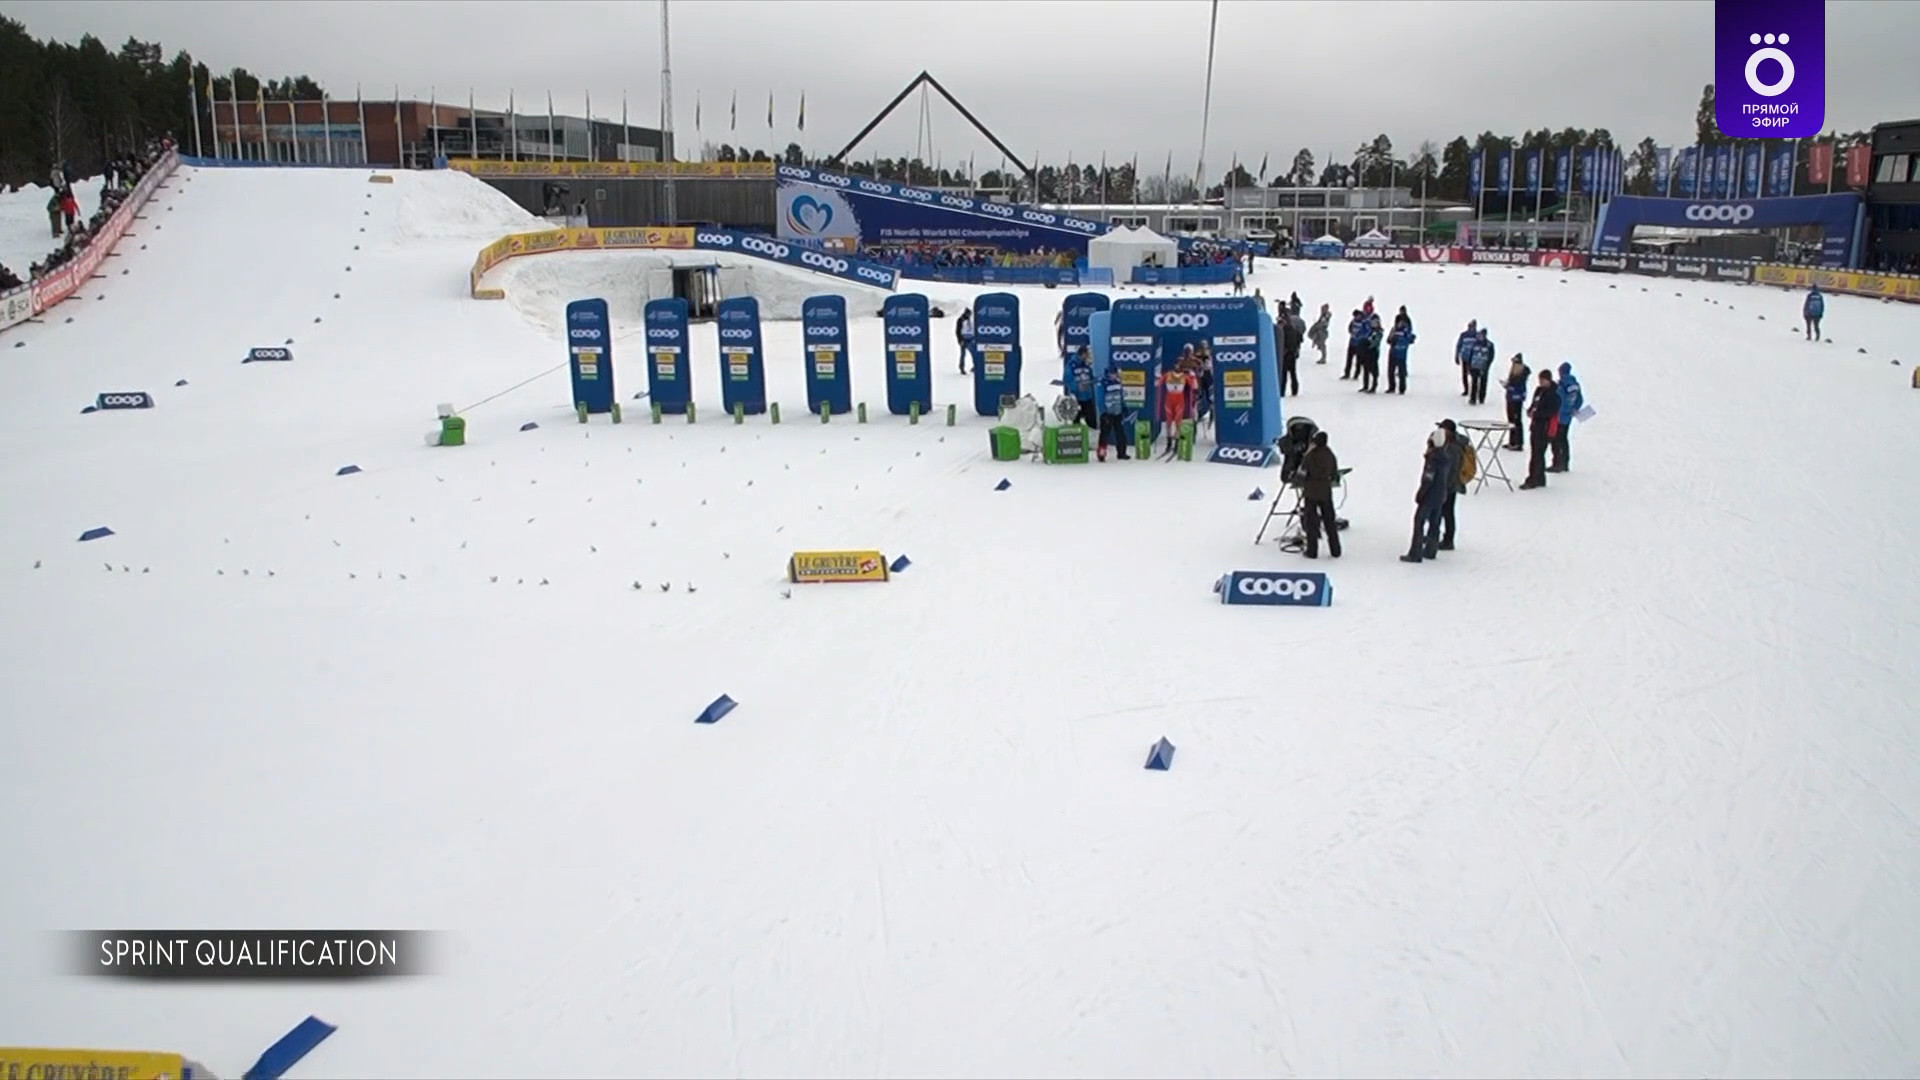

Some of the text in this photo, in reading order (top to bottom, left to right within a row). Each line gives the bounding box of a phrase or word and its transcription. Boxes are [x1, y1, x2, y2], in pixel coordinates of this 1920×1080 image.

[779, 165, 811, 179] coop
[818, 173, 851, 187] coop
[859, 180, 892, 194] coop
[900, 187, 932, 201] coop
[941, 194, 973, 209] coop
[981, 202, 1014, 217] coop
[1685, 204, 1755, 224] coop
[1022, 210, 1056, 224] coop
[1063, 217, 1096, 232] coop
[697, 232, 733, 246] coop
[922, 228, 947, 237] World
[961, 228, 1030, 239] Championships
[741, 237, 790, 258] coop
[1344, 248, 1405, 259] SVENSKA SPEL
[801, 250, 849, 273] coop
[1472, 253, 1530, 263] SVENSKA SPEL
[857, 265, 892, 283] coop
[1227, 302, 1245, 310] CUP
[1153, 313, 1210, 330] coop
[571, 329, 601, 339] coop
[648, 328, 680, 339] coop
[721, 328, 752, 339] coop
[807, 326, 839, 337] coop
[888, 326, 922, 337] coop
[977, 326, 1012, 337] coop
[1068, 326, 1090, 336] coo
[255, 349, 286, 359] coop
[1112, 351, 1151, 363] coop
[1215, 350, 1257, 364] coop
[104, 394, 144, 406] coop
[1218, 446, 1263, 463] coop
[1238, 577, 1316, 600] coop
